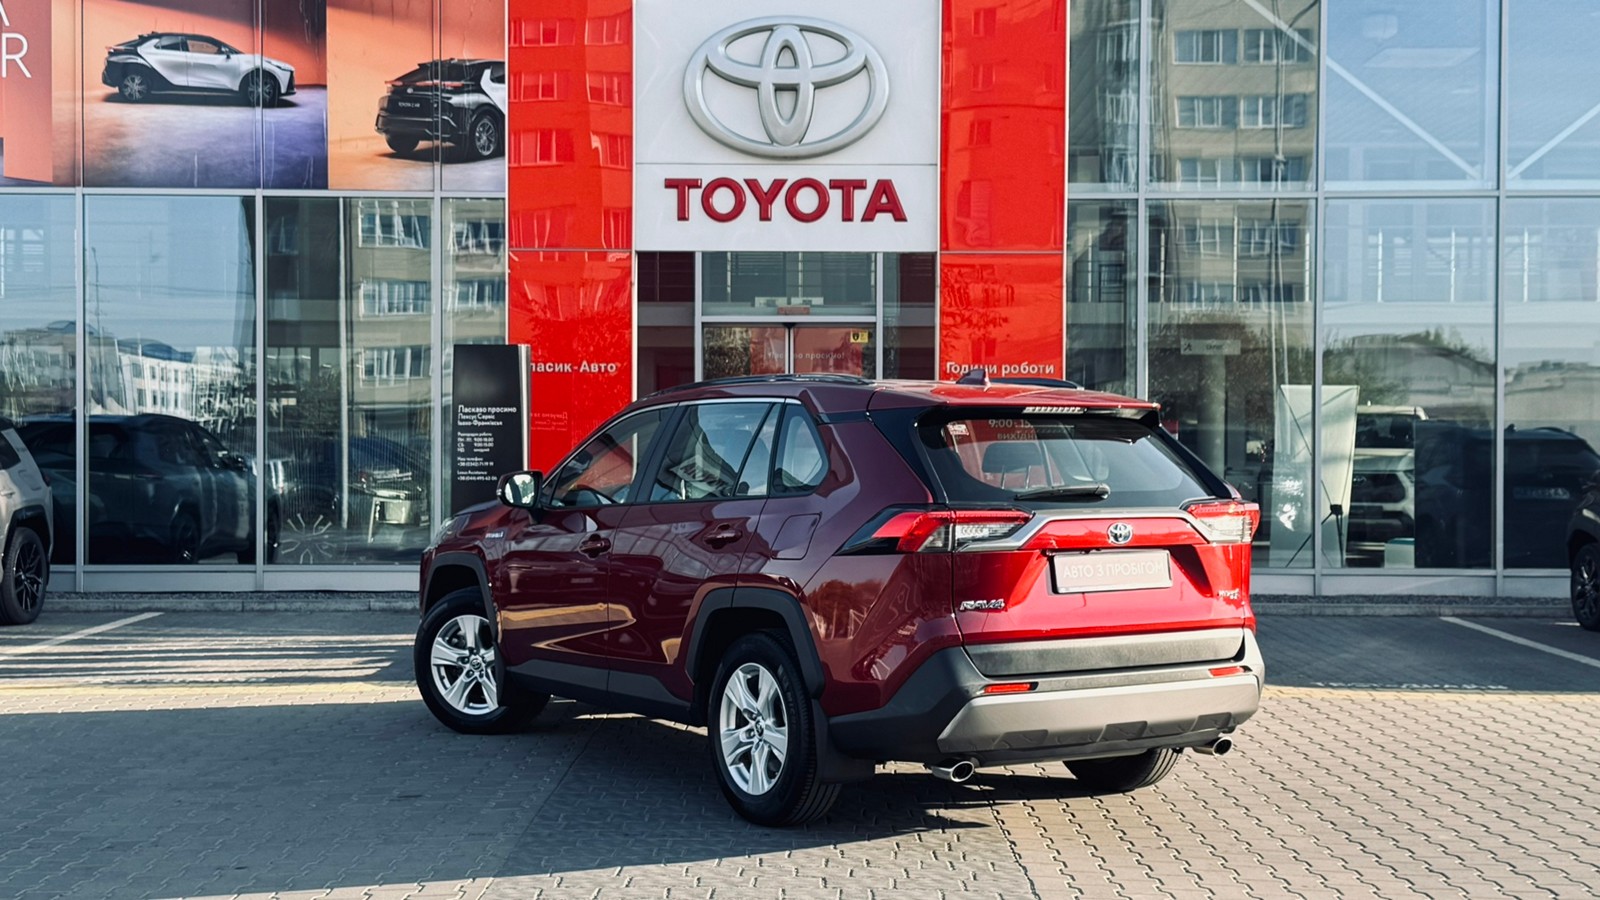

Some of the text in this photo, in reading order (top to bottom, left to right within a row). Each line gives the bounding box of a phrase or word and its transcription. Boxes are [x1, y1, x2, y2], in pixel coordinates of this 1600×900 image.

[664, 177, 908, 223] TOYOTA
[1001, 361, 1055, 377] роботи
[458, 404, 487, 413] Ласкаво
[1063, 560, 1164, 578] АВТО З ПРОБІГОМ
[959, 598, 1006, 610] RAV4
